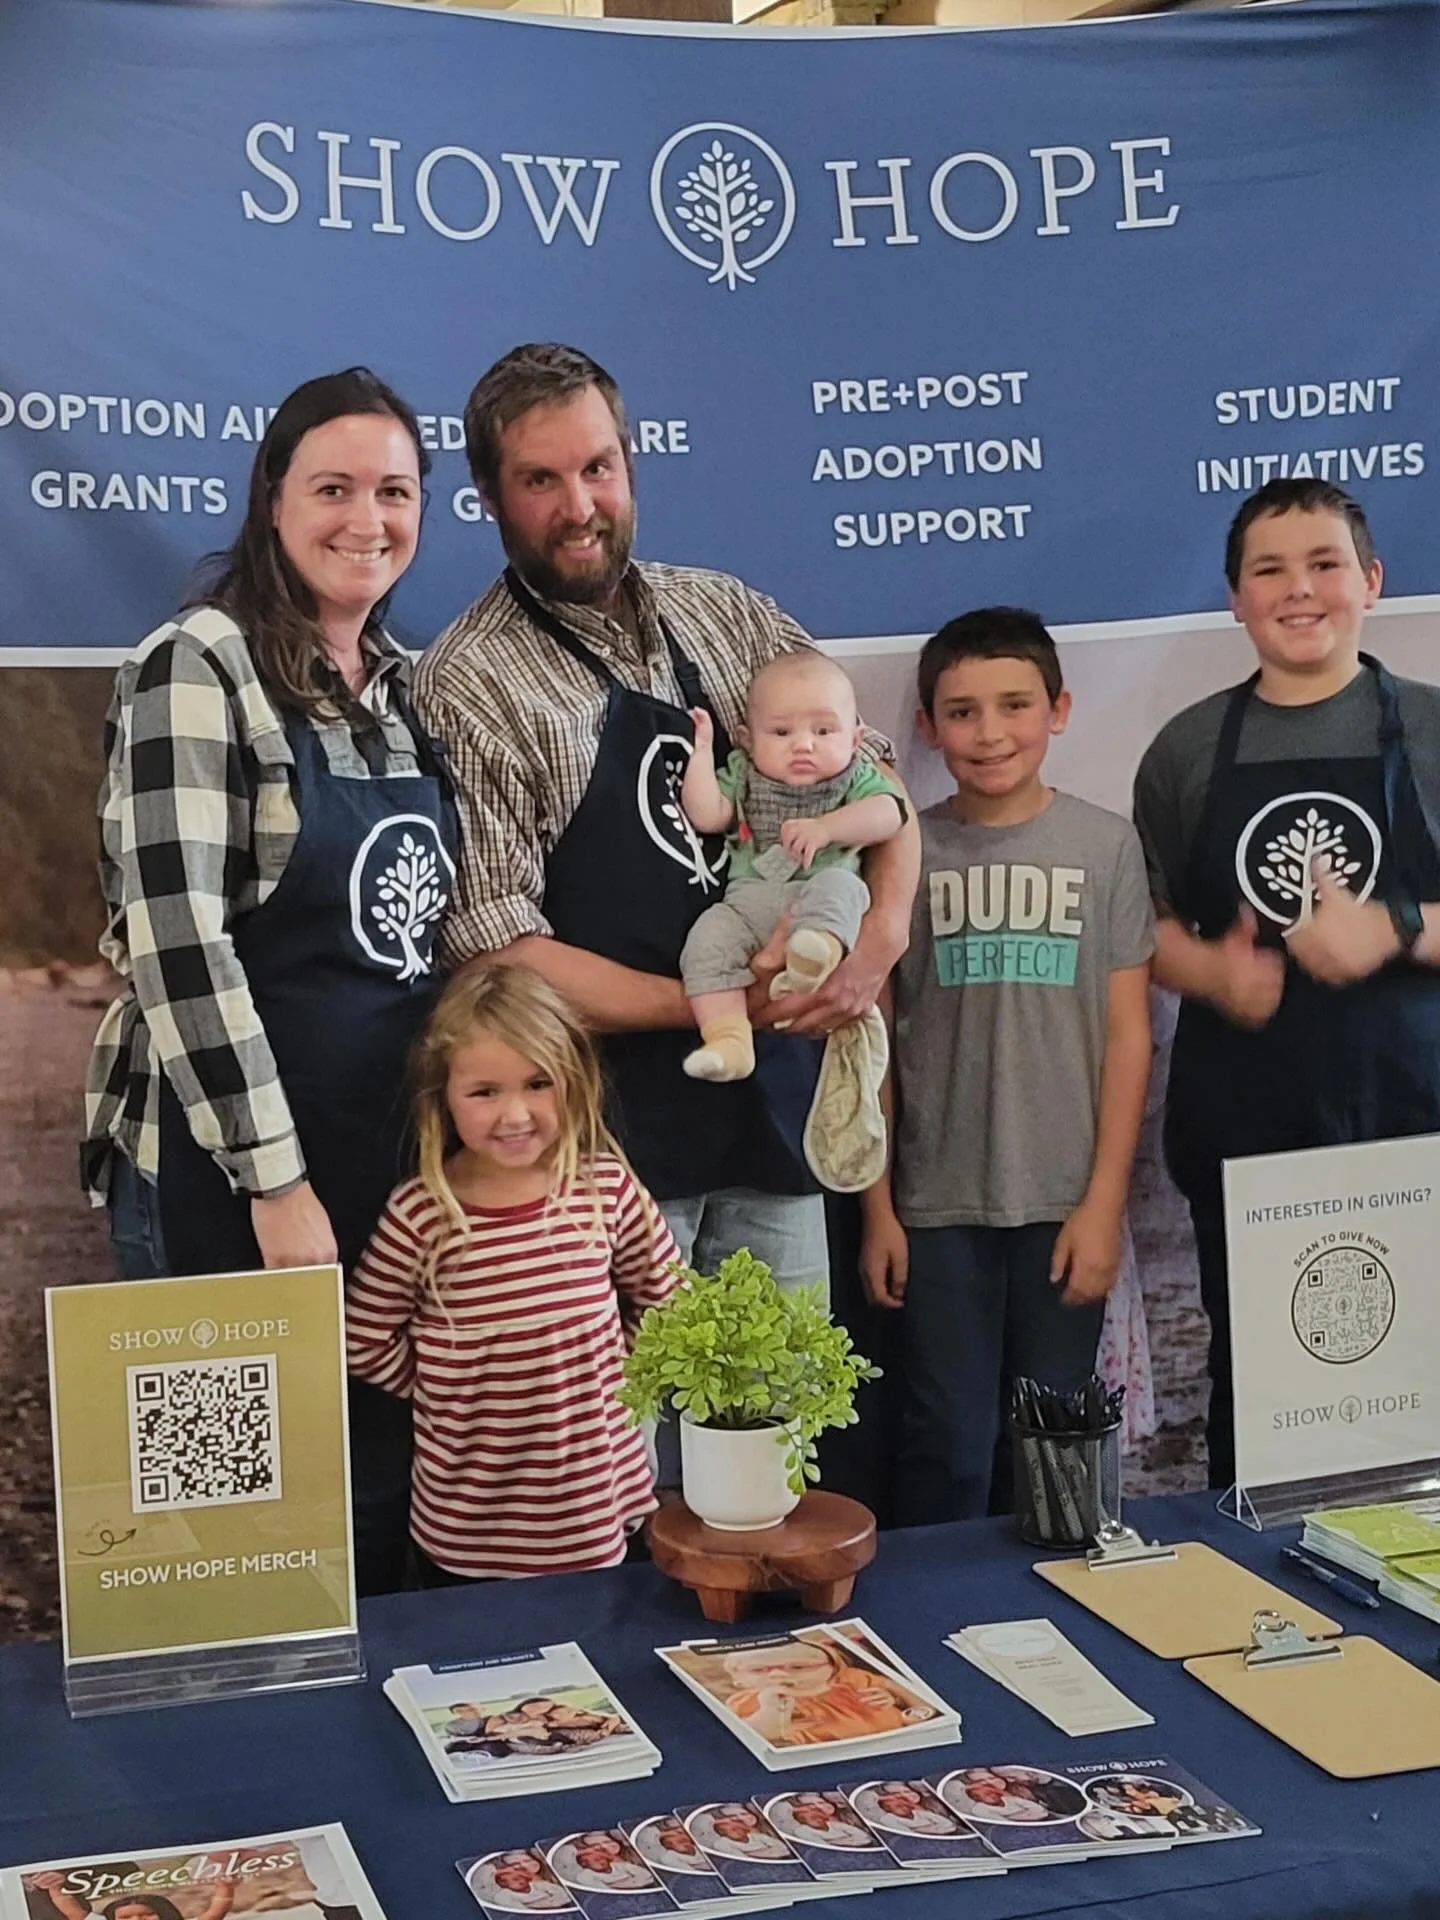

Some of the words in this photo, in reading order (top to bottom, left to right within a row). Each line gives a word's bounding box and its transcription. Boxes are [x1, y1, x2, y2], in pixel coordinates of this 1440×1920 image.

[241, 121, 621, 247] SHOW
[824, 136, 1181, 248] HOPE
[812, 370, 1030, 415] PRE+POST
[1215, 377, 1401, 425] STUDENT
[221, 405, 280, 441] AI
[812, 437, 1043, 481] ADOPTION
[1197, 442, 1425, 493] INITIATIVES
[31, 470, 228, 514] GRANTS
[834, 504, 1032, 548] SUPPORT
[929, 864, 1085, 936] DUDE
[949, 941, 1068, 979] PERFECT
[1245, 1199, 1343, 1224] INTERESTED
[1347, 1195, 1364, 1212] IN
[1368, 1187, 1432, 1209] GIVING?
[1294, 1240, 1320, 1267] SCAN
[1321, 1233, 1336, 1245] TO
[1339, 1231, 1364, 1242] GIVE
[1366, 1235, 1390, 1255] NOW
[109, 1327, 184, 1350] SHOW
[224, 1319, 290, 1341] HOPE
[1272, 1404, 1335, 1430] SHOW
[1366, 1391, 1422, 1415] HOPE
[100, 1564, 170, 1589] SHOW
[175, 1557, 236, 1581] HOPE
[241, 1549, 317, 1574] MERCH
[61, 1850, 297, 1900] Speechless
